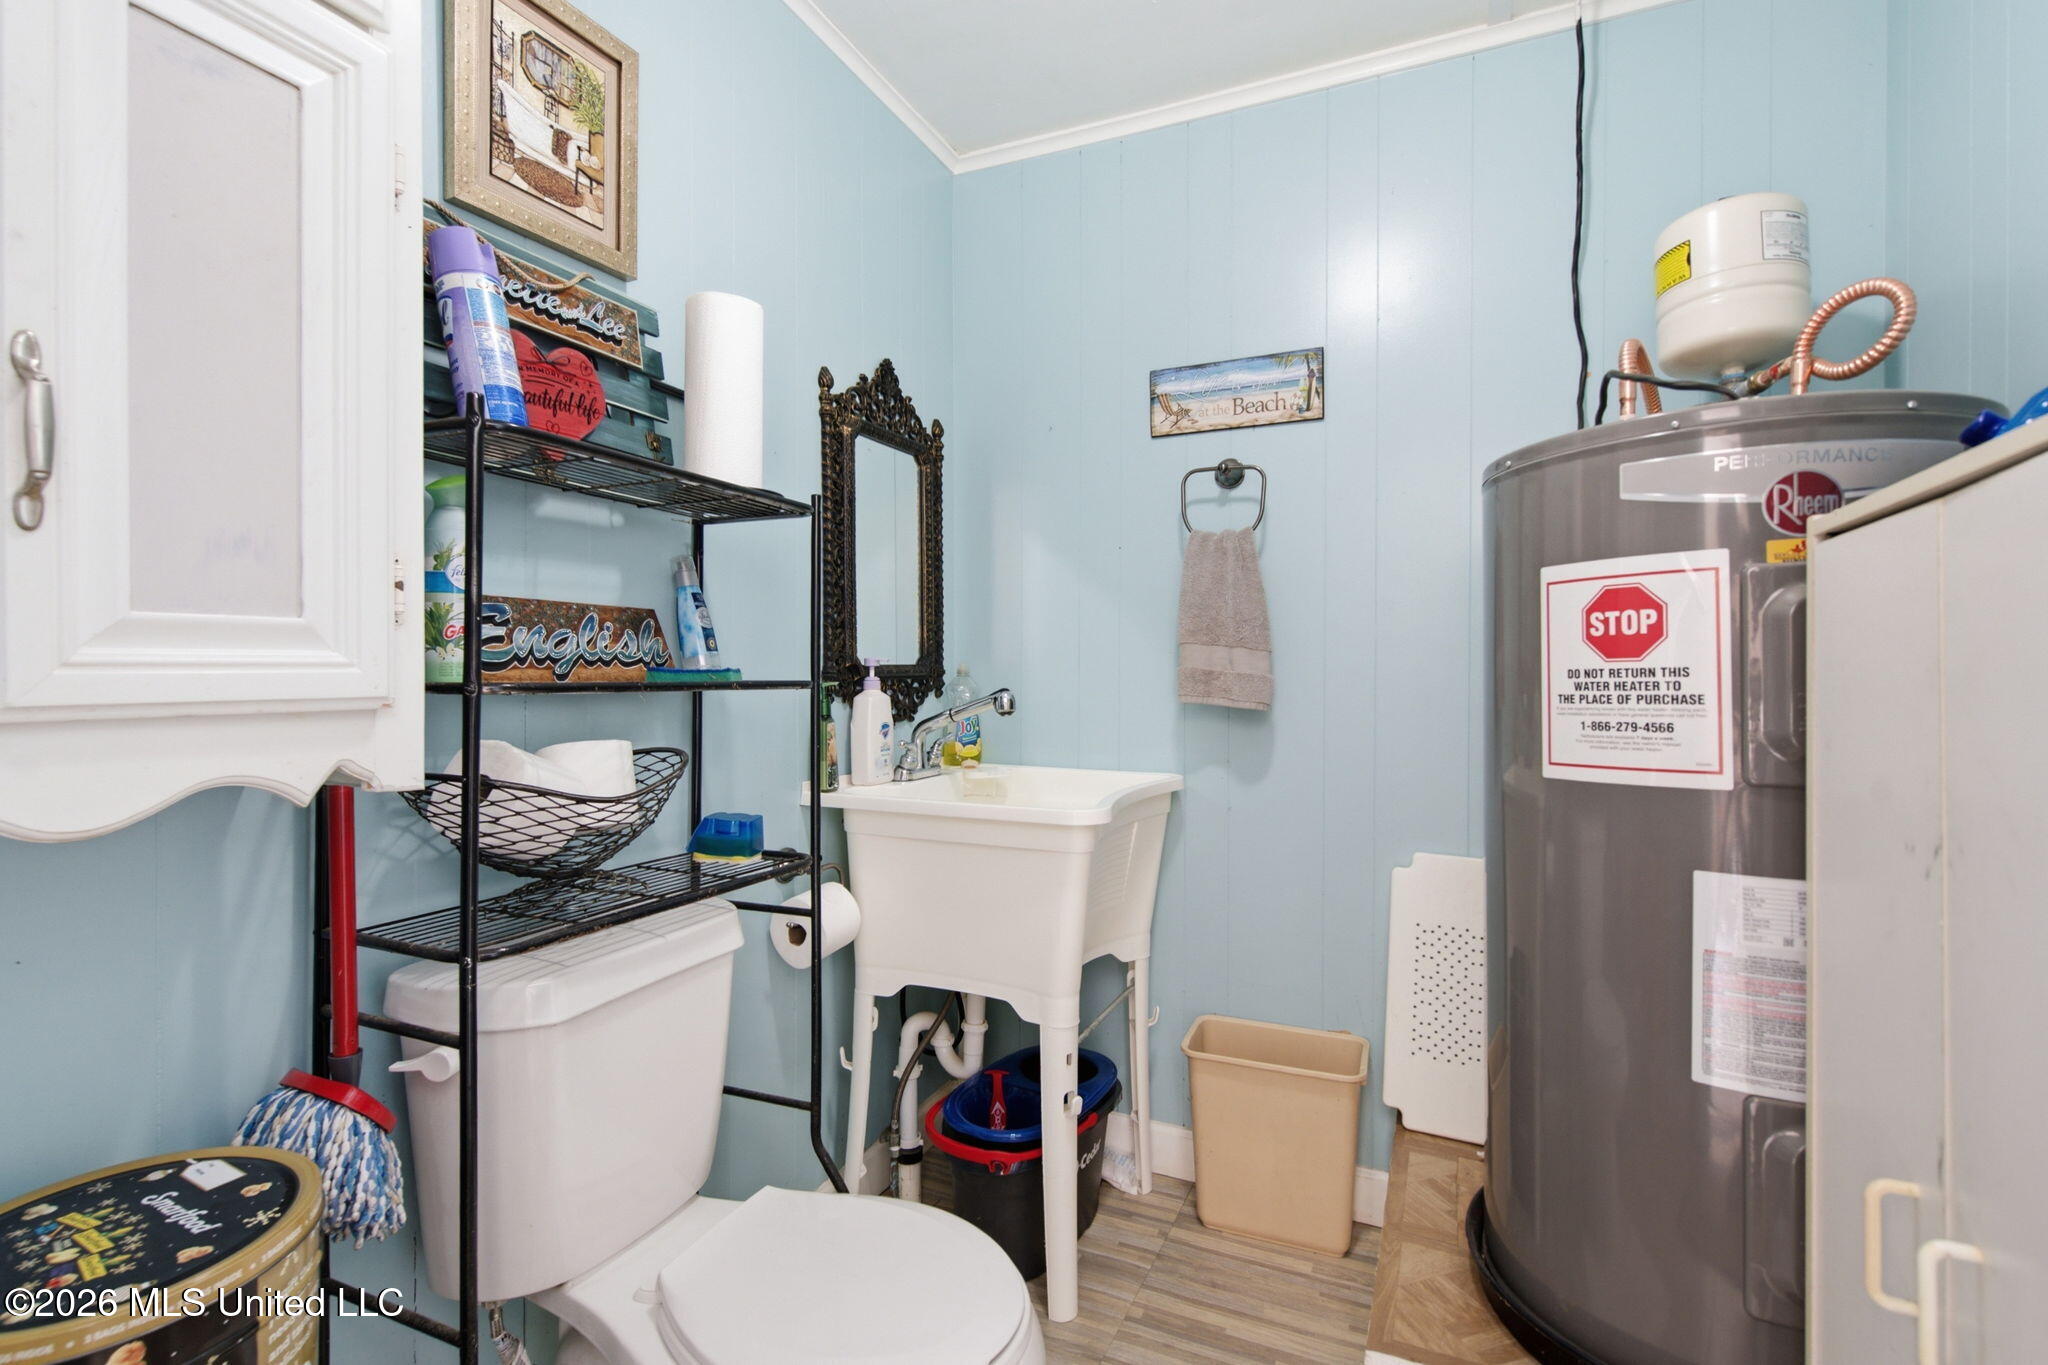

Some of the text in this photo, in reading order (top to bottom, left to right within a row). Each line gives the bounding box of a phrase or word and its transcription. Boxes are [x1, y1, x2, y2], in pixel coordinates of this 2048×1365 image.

[579, 301, 628, 341] Lee
[524, 388, 575, 418] autiful
[1212, 404, 1231, 417] the
[1232, 391, 1287, 417] Beach
[1772, 472, 1840, 526] Rheem
[1589, 608, 1658, 637] STOP
[481, 602, 670, 677] English
[1567, 666, 1691, 680] DO NOT RETURN THIS
[1573, 680, 1682, 692] WATER HEATER TO
[1558, 694, 1706, 706] THE PLACE OF PURCHASE
[1580, 721, 1675, 734] 1-866-279-4566
[140, 1191, 223, 1235] Smartfood
